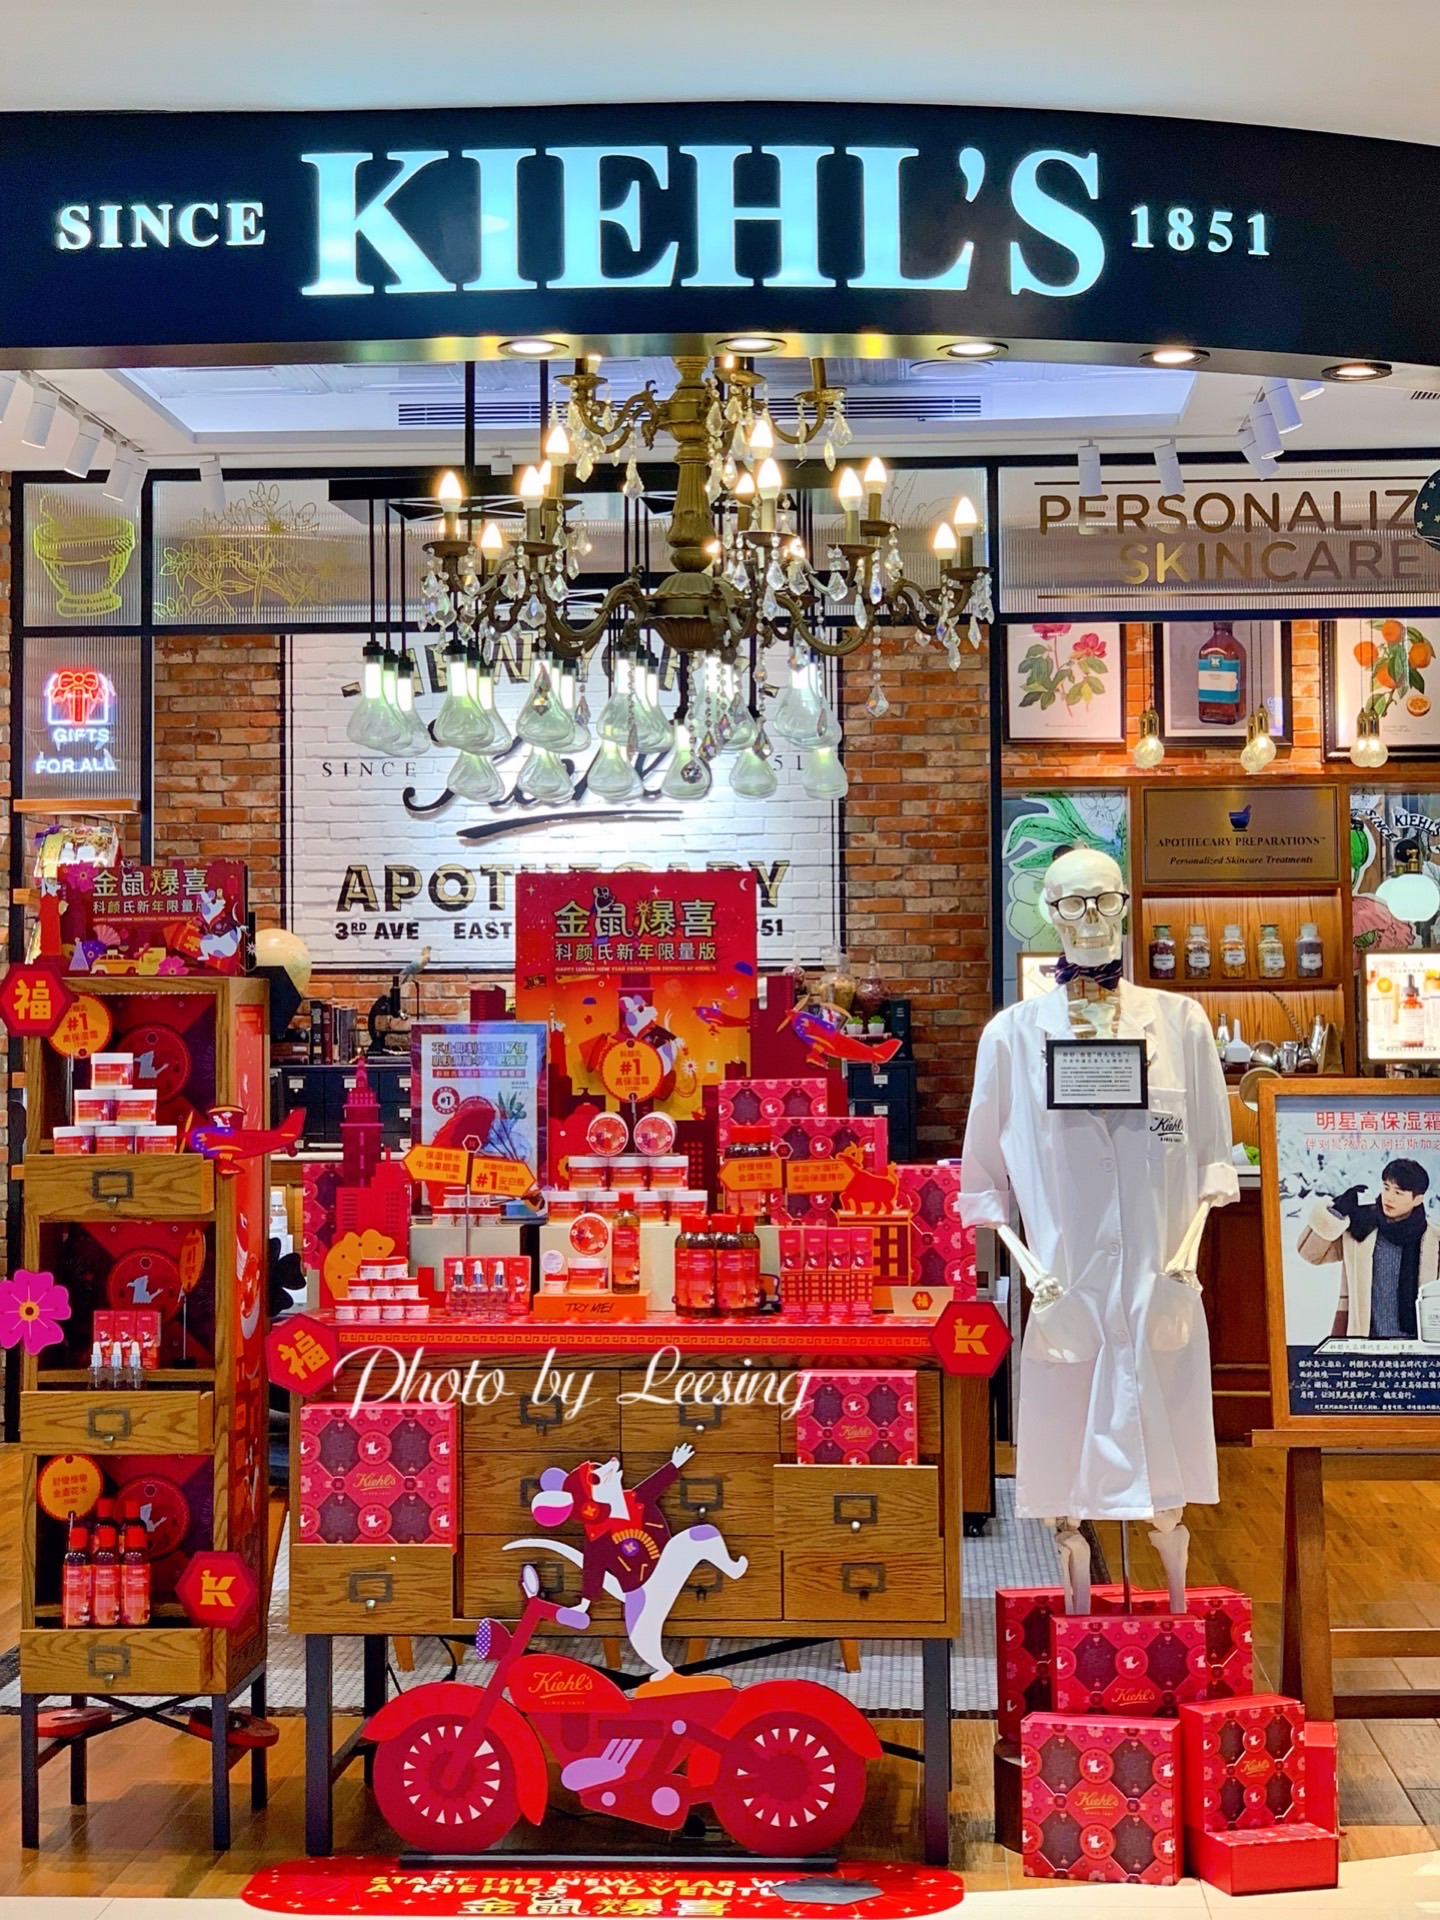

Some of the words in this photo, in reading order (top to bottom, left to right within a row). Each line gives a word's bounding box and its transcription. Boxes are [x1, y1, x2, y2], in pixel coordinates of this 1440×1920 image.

[57, 202, 266, 250] SINCE
[300, 144, 1107, 298] KIEHL'S
[1130, 204, 1271, 257] 1851
[1038, 489, 1419, 536] PERSONALIZ
[1117, 540, 1424, 585] SKINCARE
[53, 728, 110, 743] GIFTS
[35, 758, 75, 774] FOR
[79, 757, 116, 772] ALL
[321, 761, 417, 778] SINCE
[1156, 836, 1232, 848] APOTHECARY
[1169, 856, 1224, 866] Personalized
[1226, 856, 1264, 864] Skincare
[1266, 855, 1313, 864] Treatments
[92, 867, 209, 897] 金鼠爆喜
[553, 898, 718, 938] 金鼠爆喜
[374, 922, 420, 940] AVE
[453, 922, 512, 940] EAST
[555, 941, 717, 962] 科颜氏新年限量版
[13, 979, 52, 1020] 福
[67, 1013, 89, 1031] #1
[620, 1058, 641, 1076] #1
[1316, 1111, 1440, 1131] 明星高保湿霜
[565, 1302, 589, 1312] TRY
[590, 1302, 615, 1313] ME!
[277, 1329, 330, 1380] 福
[353, 1472, 396, 1488] Kiehl's
[528, 1671, 593, 1694] Kiehl's
[1111, 1687, 1156, 1703] Kiehl's
[1074, 1791, 1120, 1807] Kiehl's
[364, 1884, 393, 1892] A
[412, 1884, 569, 1894] KIEHL'S
[370, 1876, 470, 1884] START
[483, 1877, 542, 1885] THE
[555, 1878, 637, 1886] NEW
[651, 1879, 737, 1887] YEAR
[457, 1896, 733, 1916] 金鼠爆喜
